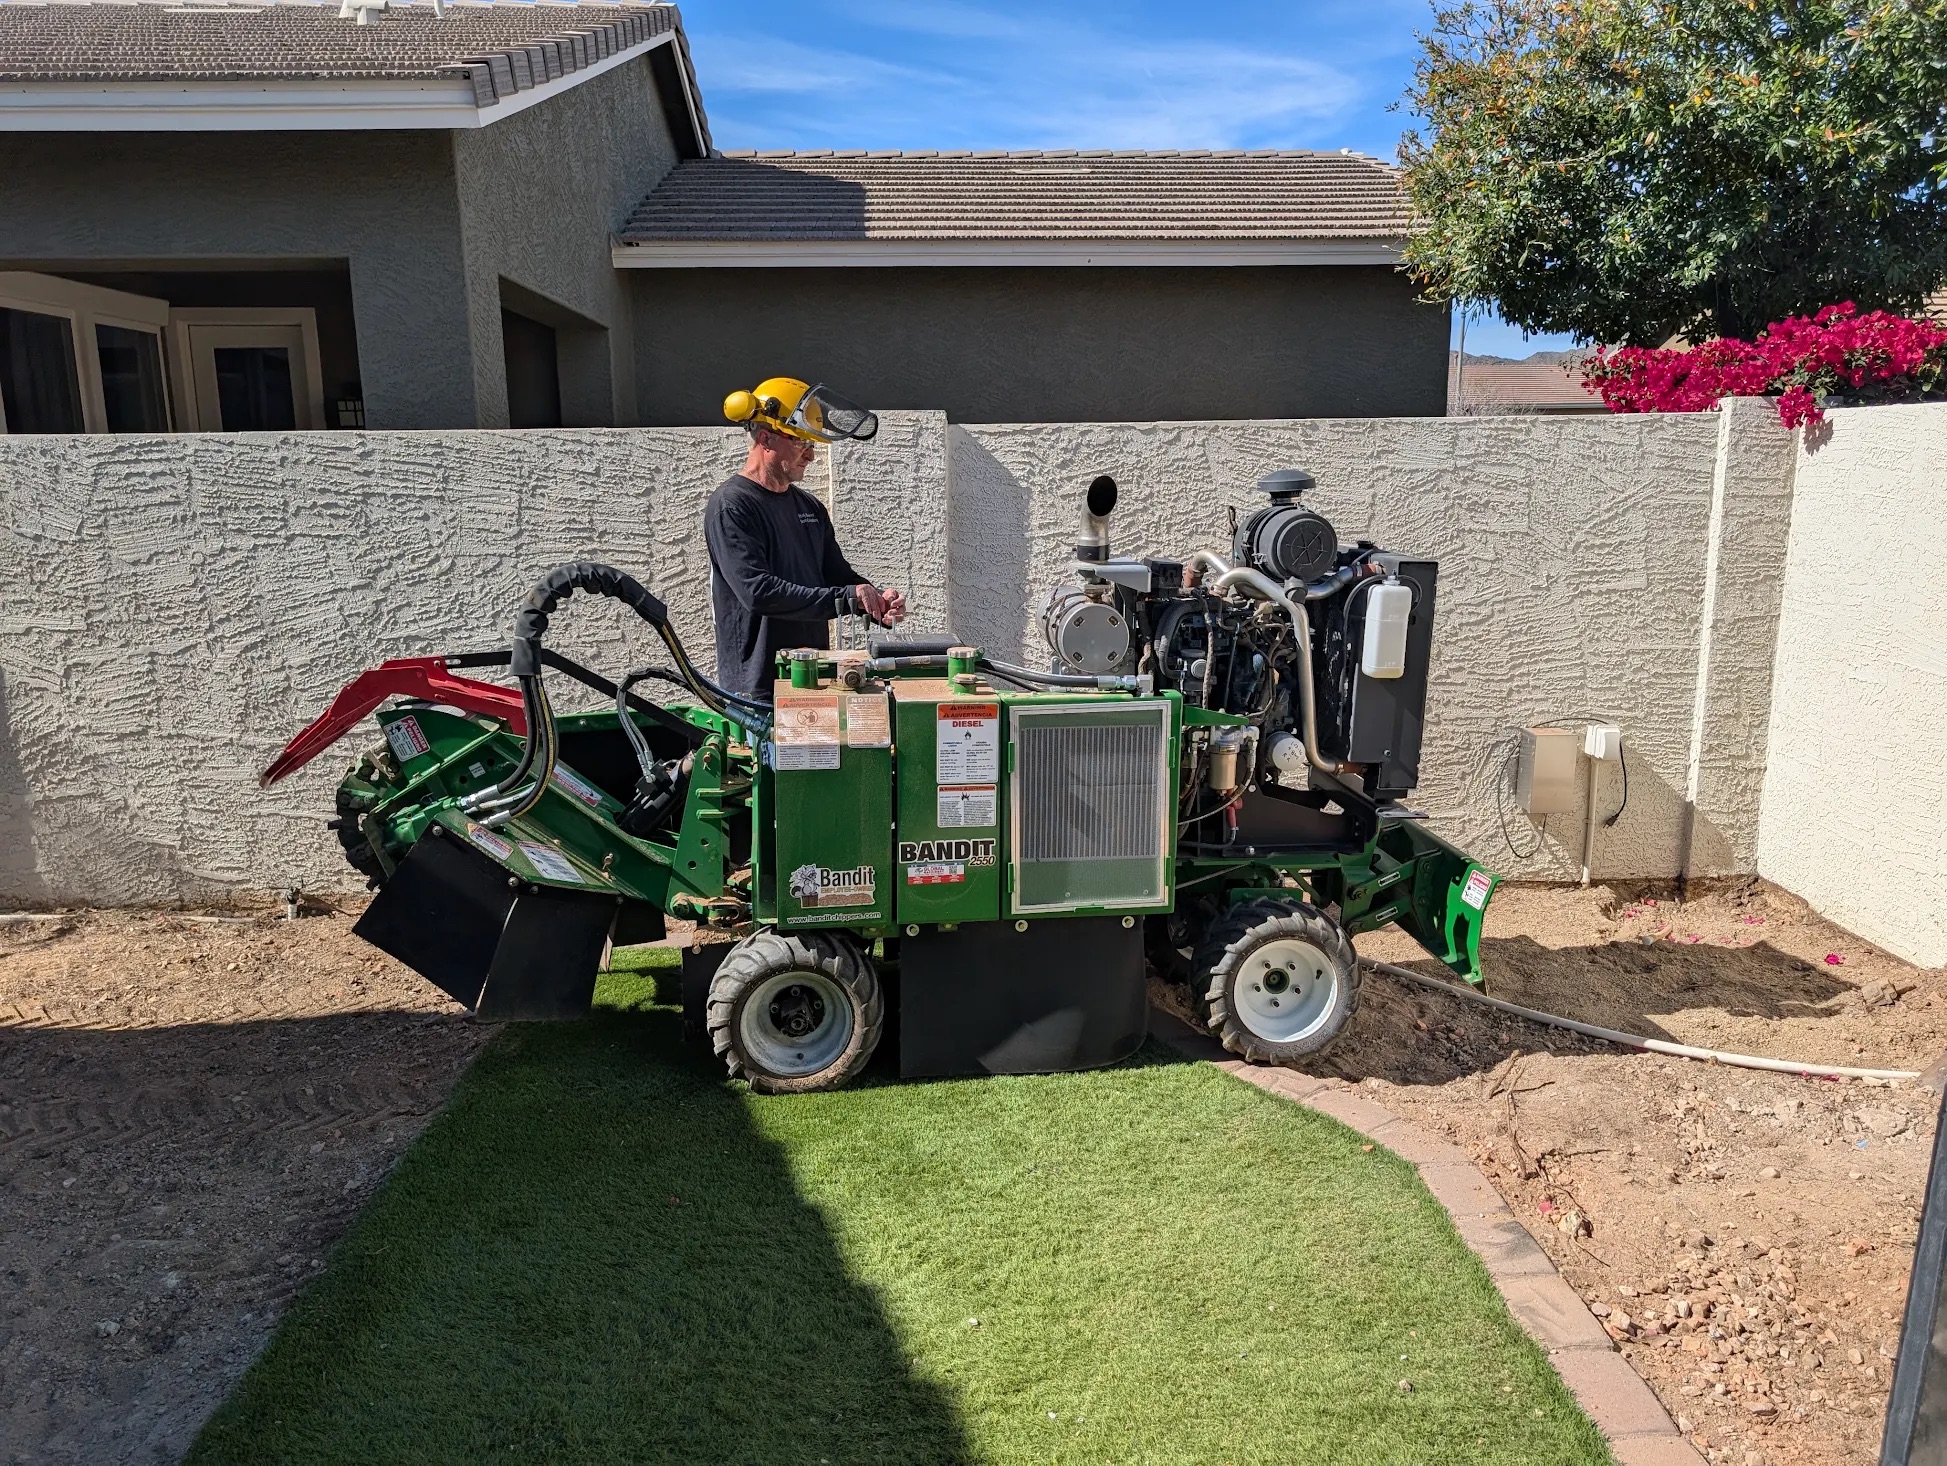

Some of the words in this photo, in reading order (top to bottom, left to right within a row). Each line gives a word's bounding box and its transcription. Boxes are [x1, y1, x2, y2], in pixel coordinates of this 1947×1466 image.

[952, 720, 984, 728] DIESEL
[900, 840, 995, 862] BANDIT
[969, 855, 995, 866] 2550
[820, 867, 874, 887] Bandit
[787, 912, 881, 924] www.banditchippers.com
